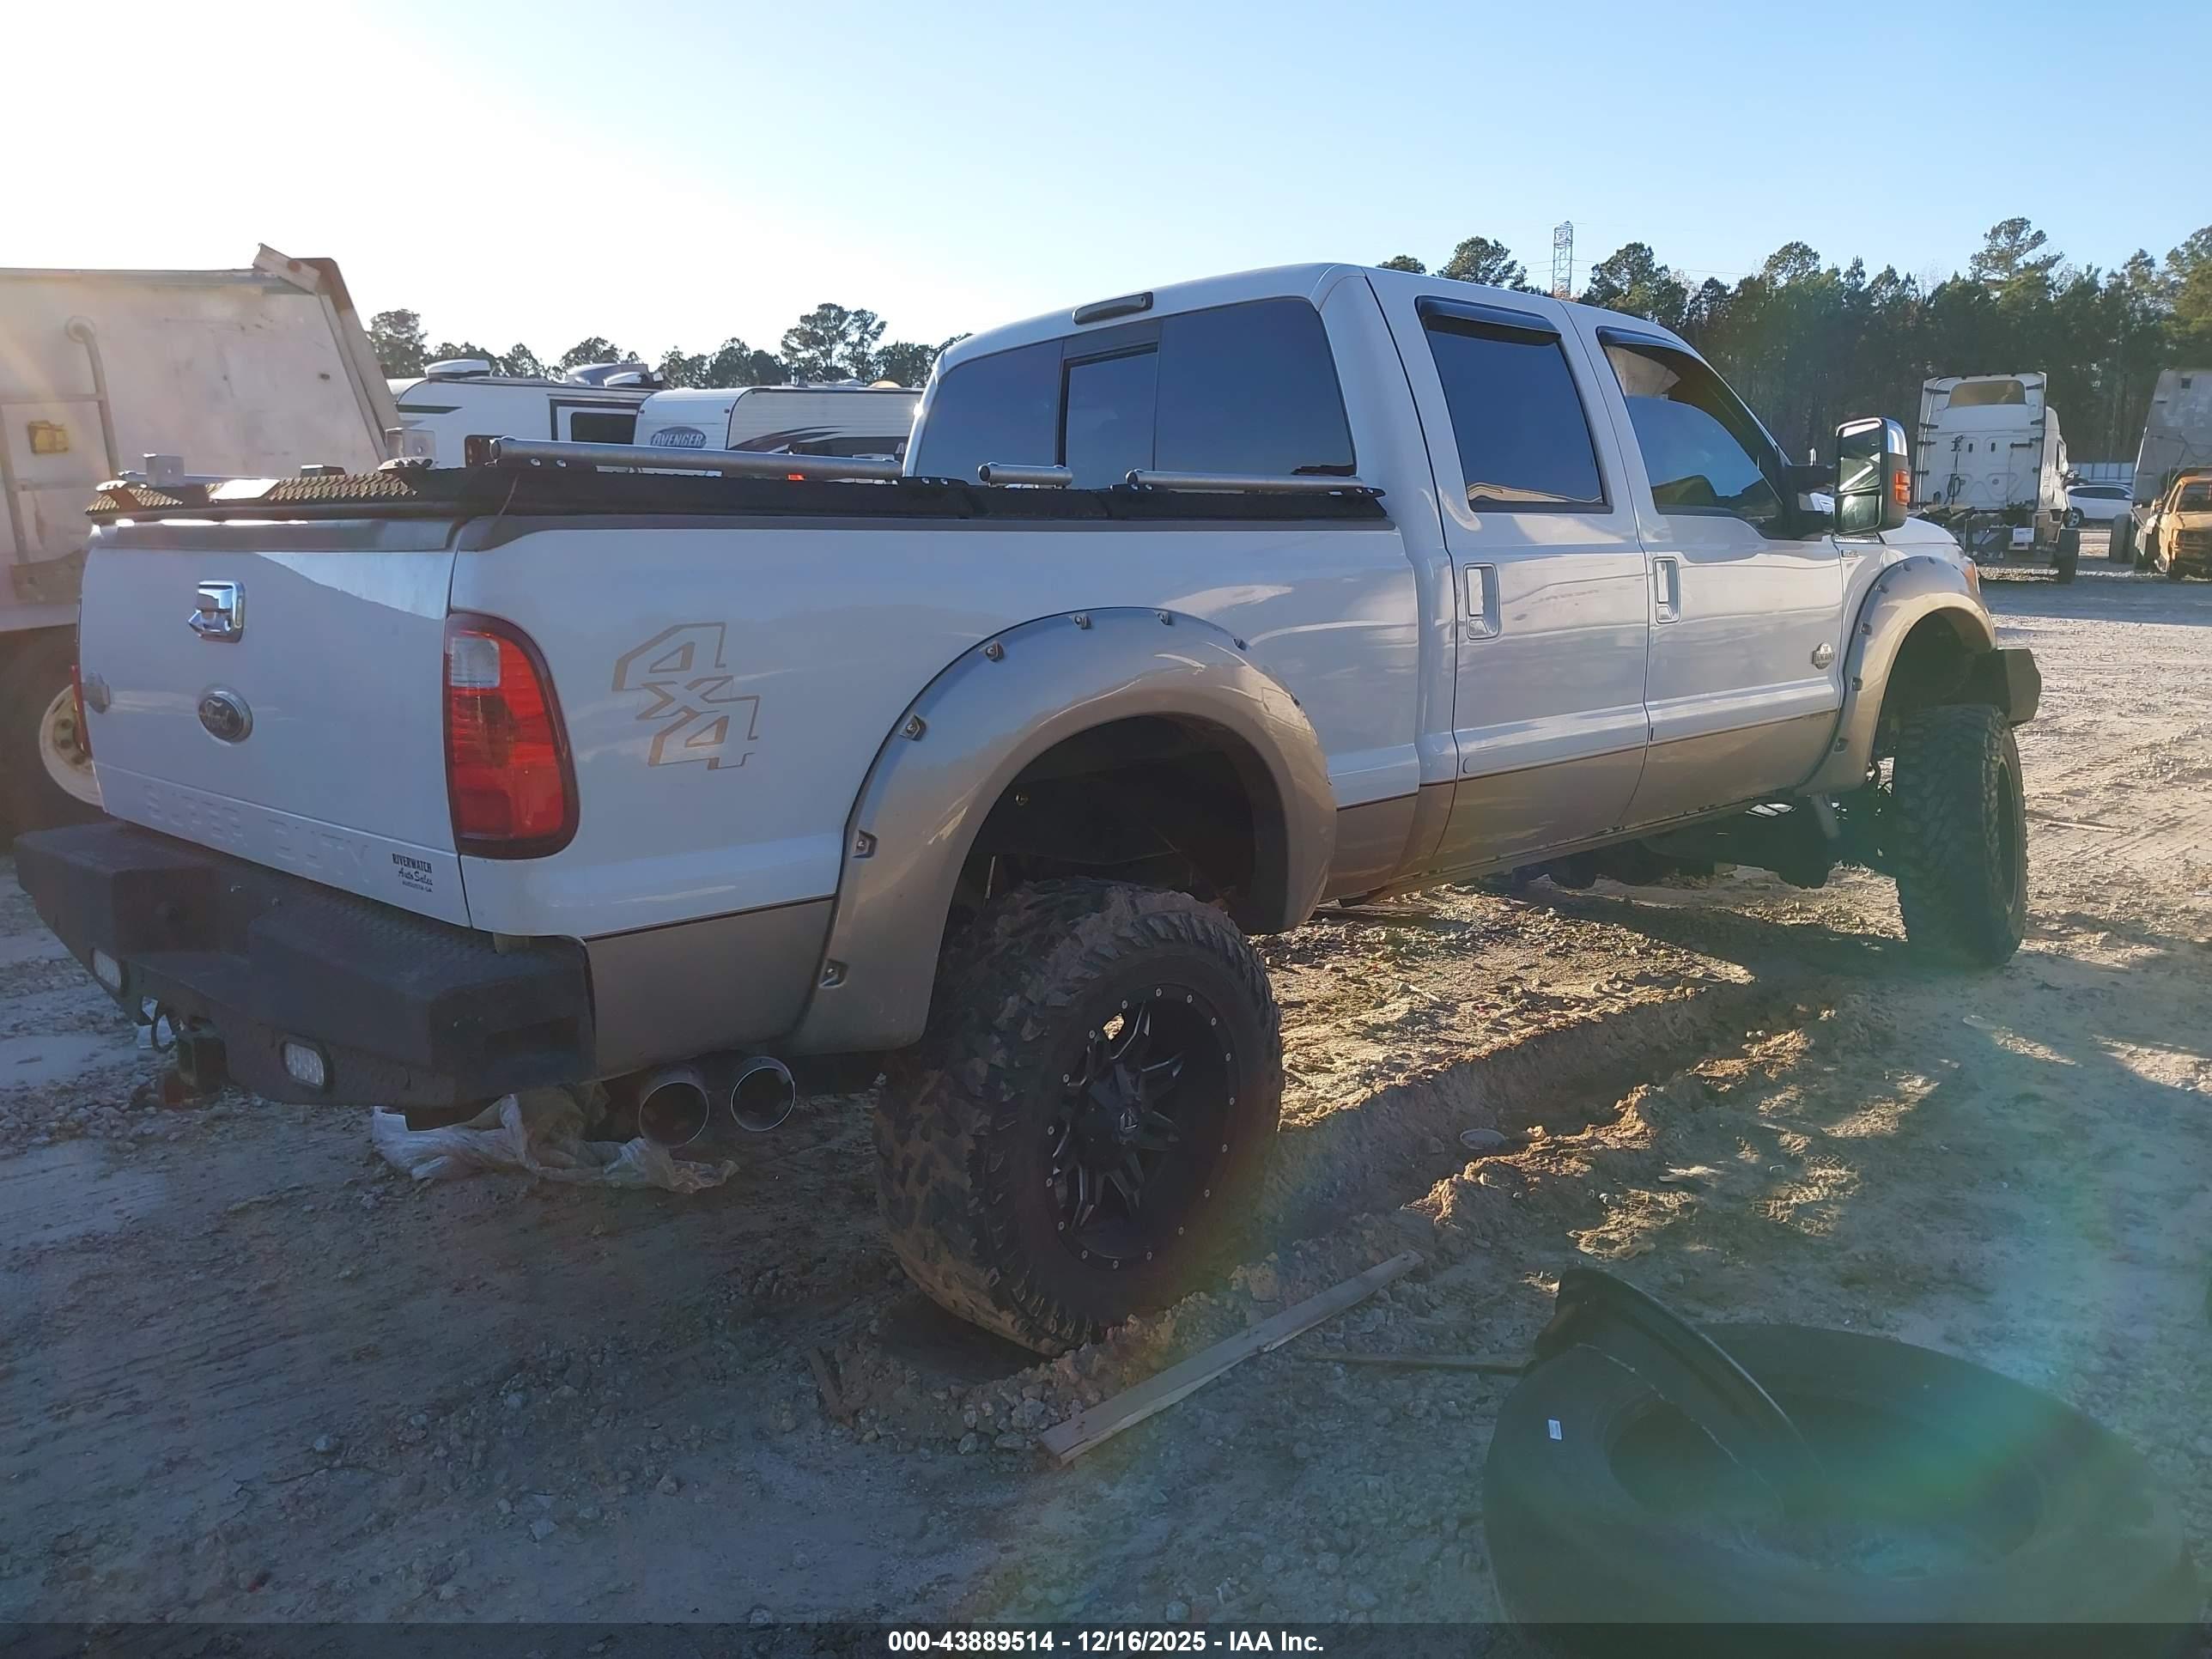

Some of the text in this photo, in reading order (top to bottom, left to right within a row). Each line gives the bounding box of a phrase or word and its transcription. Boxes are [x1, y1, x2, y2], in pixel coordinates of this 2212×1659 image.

[652, 433, 704, 447] AVENGER
[392, 853, 432, 873] RIVERWATCH
[398, 867, 433, 885] Auto Sales
